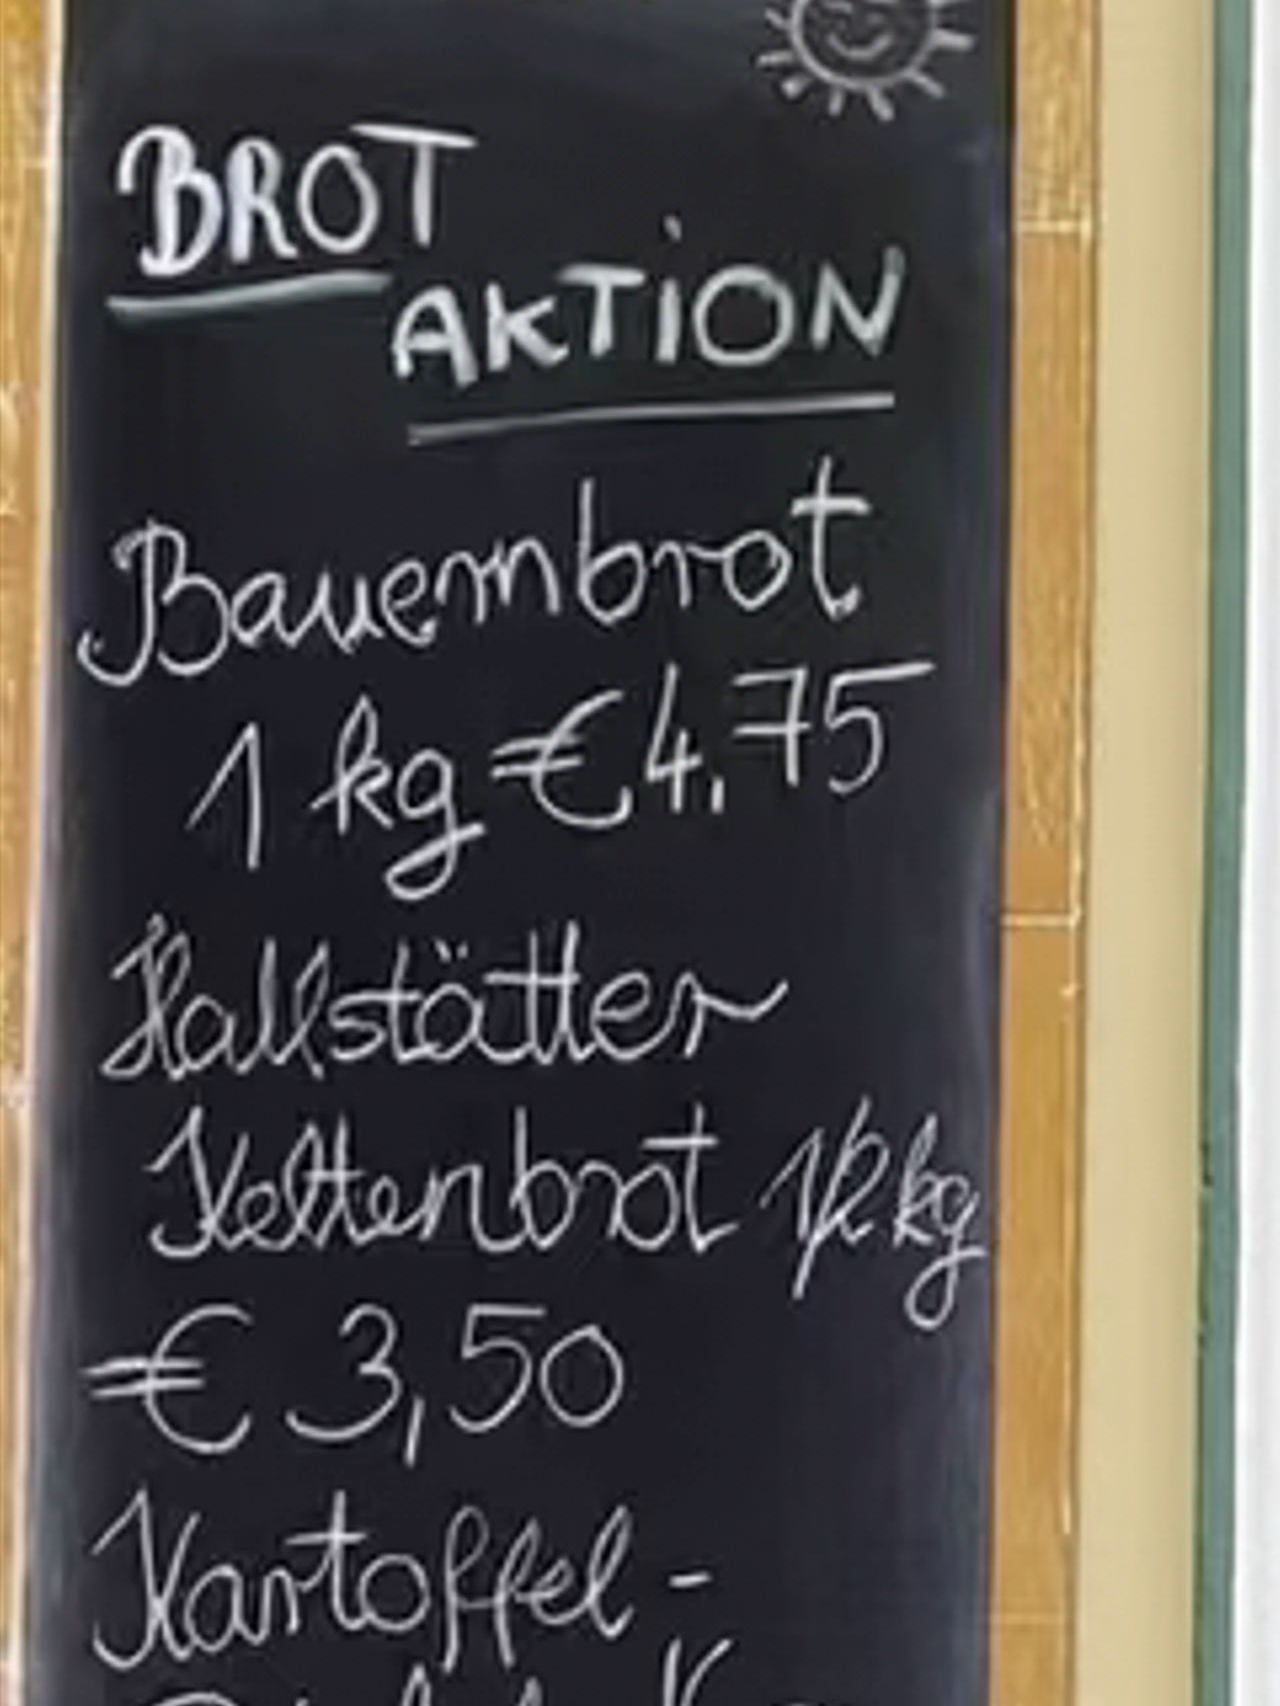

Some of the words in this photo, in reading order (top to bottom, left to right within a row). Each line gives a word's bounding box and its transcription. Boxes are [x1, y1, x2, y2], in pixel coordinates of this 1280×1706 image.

[117, 123, 477, 278] BROT
[77, 456, 870, 685] Bauernbrot
[184, 721, 264, 871] 1
[100, 913, 790, 1081] Hallstätter
